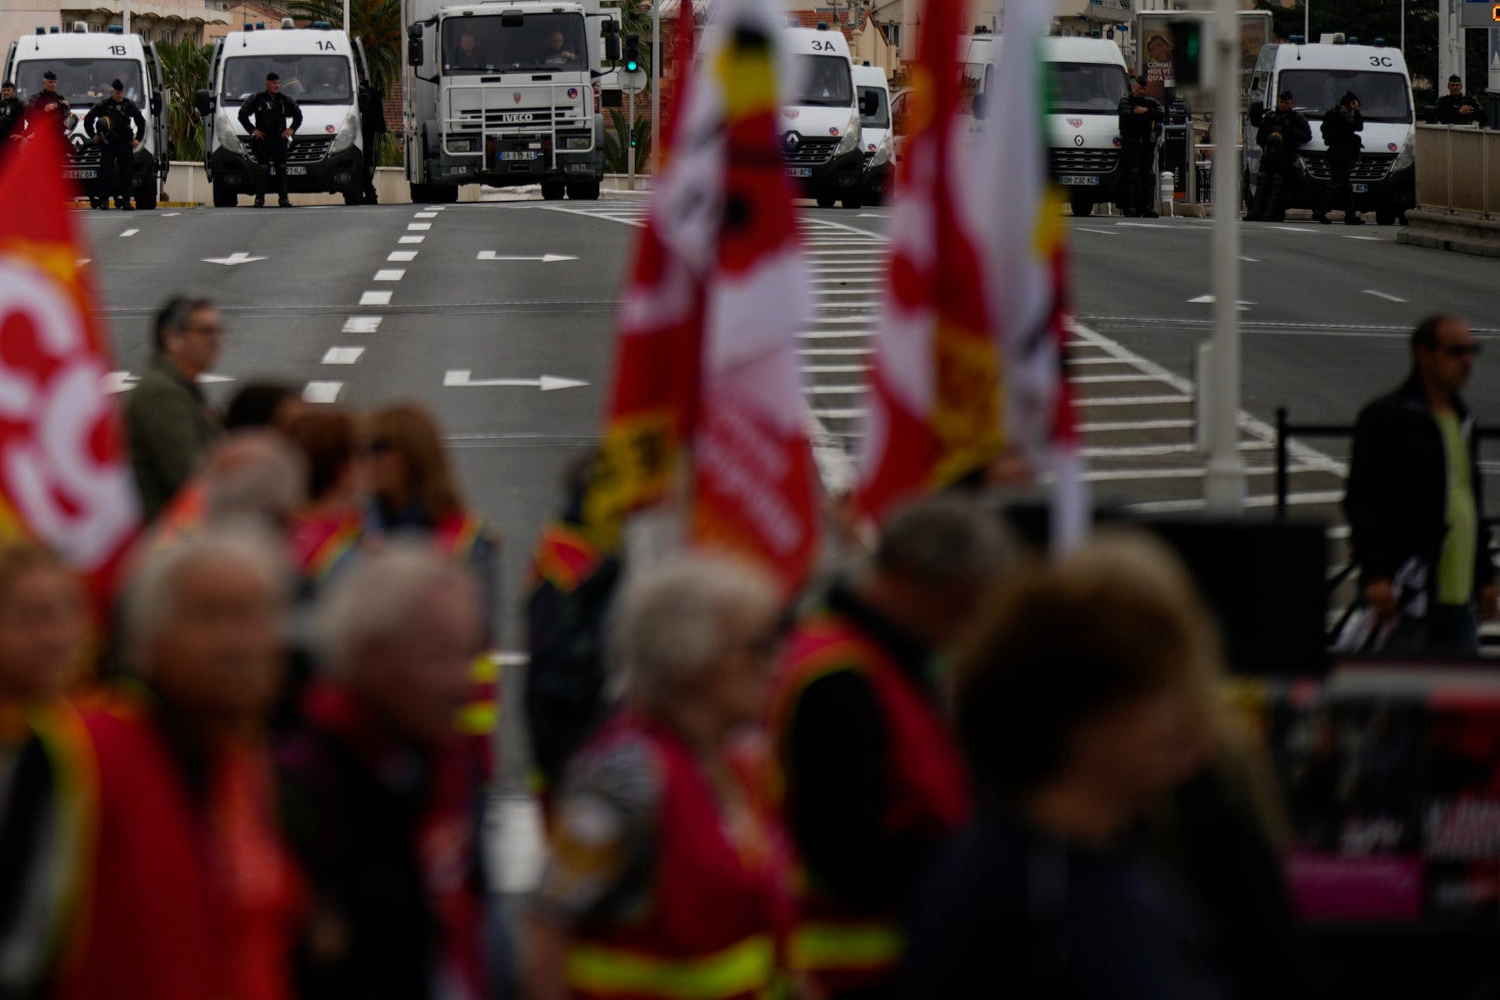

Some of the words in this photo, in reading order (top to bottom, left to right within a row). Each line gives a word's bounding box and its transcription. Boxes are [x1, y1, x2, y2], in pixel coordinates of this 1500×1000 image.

[108, 45, 127, 56] 1B
[315, 40, 336, 52] 1A
[811, 40, 836, 52] 3A
[1369, 56, 1393, 68] 3C
[502, 113, 534, 123] IVECO
